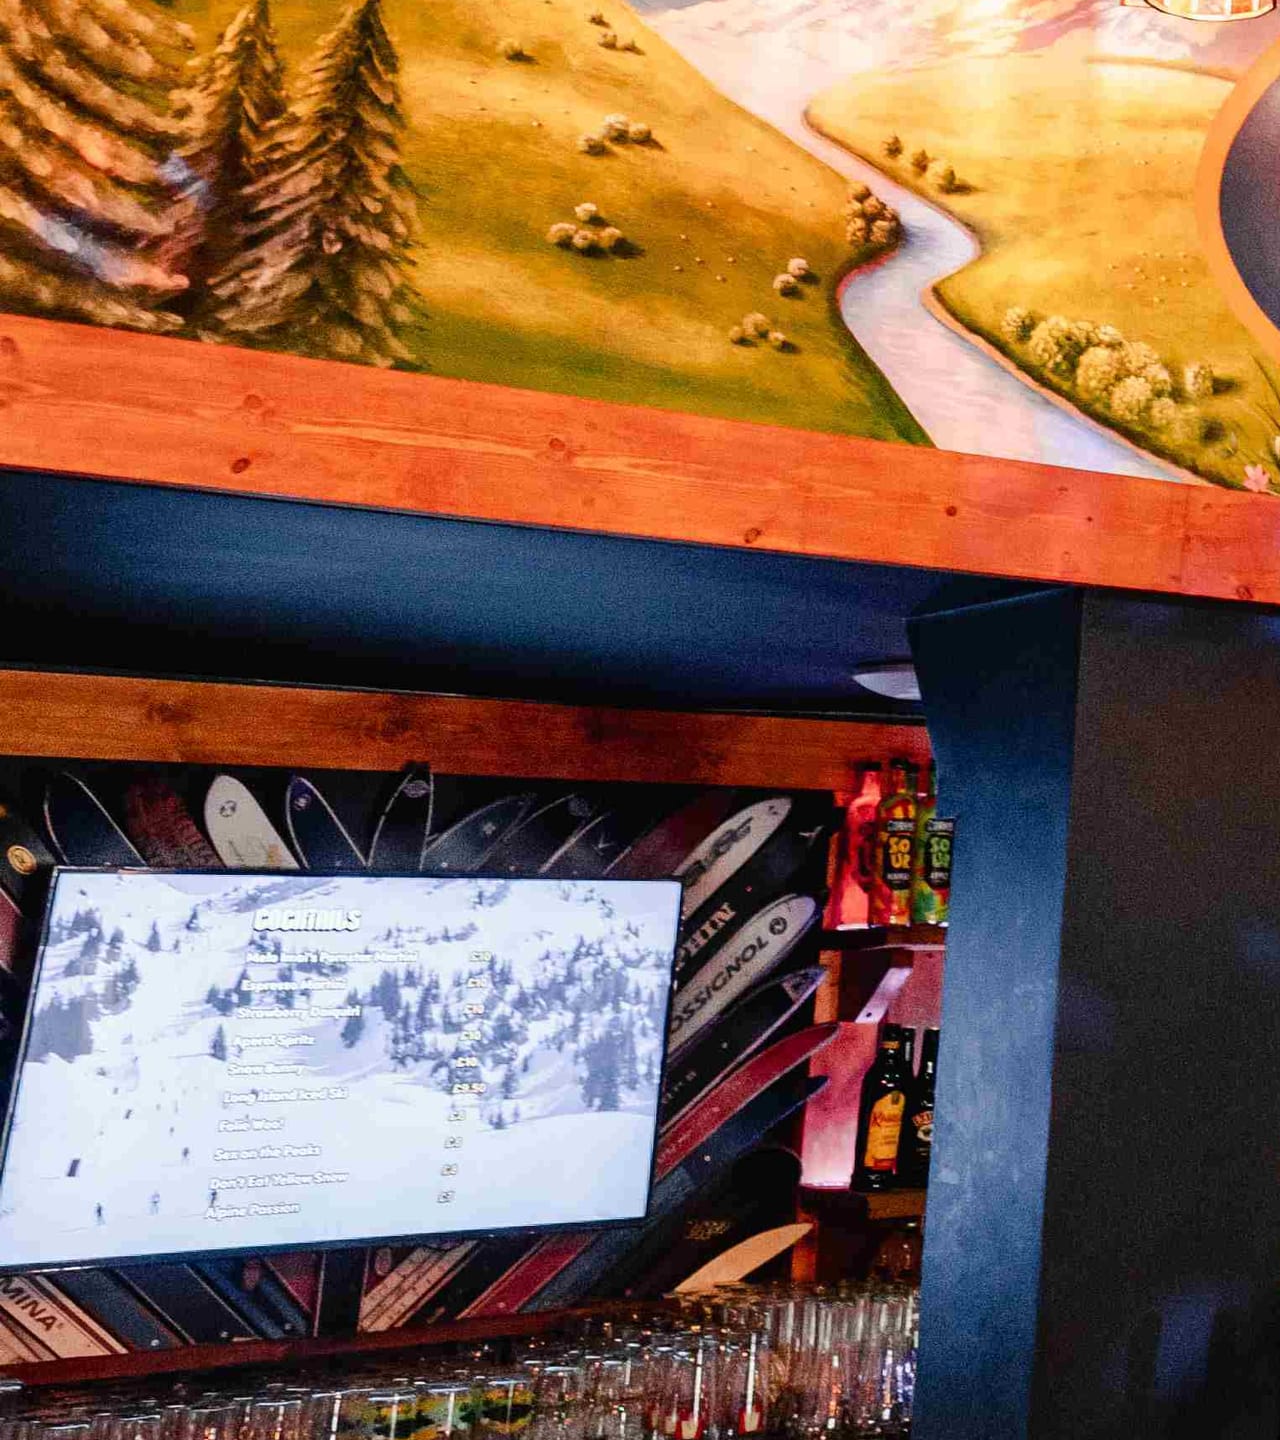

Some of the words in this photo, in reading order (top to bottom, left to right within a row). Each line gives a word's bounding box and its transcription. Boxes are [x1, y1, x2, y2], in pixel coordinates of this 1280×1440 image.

[236, 1006, 309, 1020] Strawberry
[233, 1034, 278, 1049] Aperol
[277, 1034, 316, 1048] Spritz
[227, 1063, 263, 1077] Snow
[223, 1090, 257, 1106] Long
[256, 1089, 297, 1103] Island
[299, 1087, 328, 1101] Iced
[328, 1086, 350, 1100] Ski
[213, 1147, 240, 1161] Sex
[239, 1149, 258, 1160] on
[258, 1145, 283, 1159] the
[282, 1144, 322, 1158] Peaks
[208, 1176, 246, 1191] Don't
[247, 1175, 270, 1189] Eat
[270, 1173, 314, 1187] Yellow
[313, 1171, 350, 1185] Snow
[204, 1205, 248, 1221] Alpine
[248, 1202, 301, 1217] Passion
